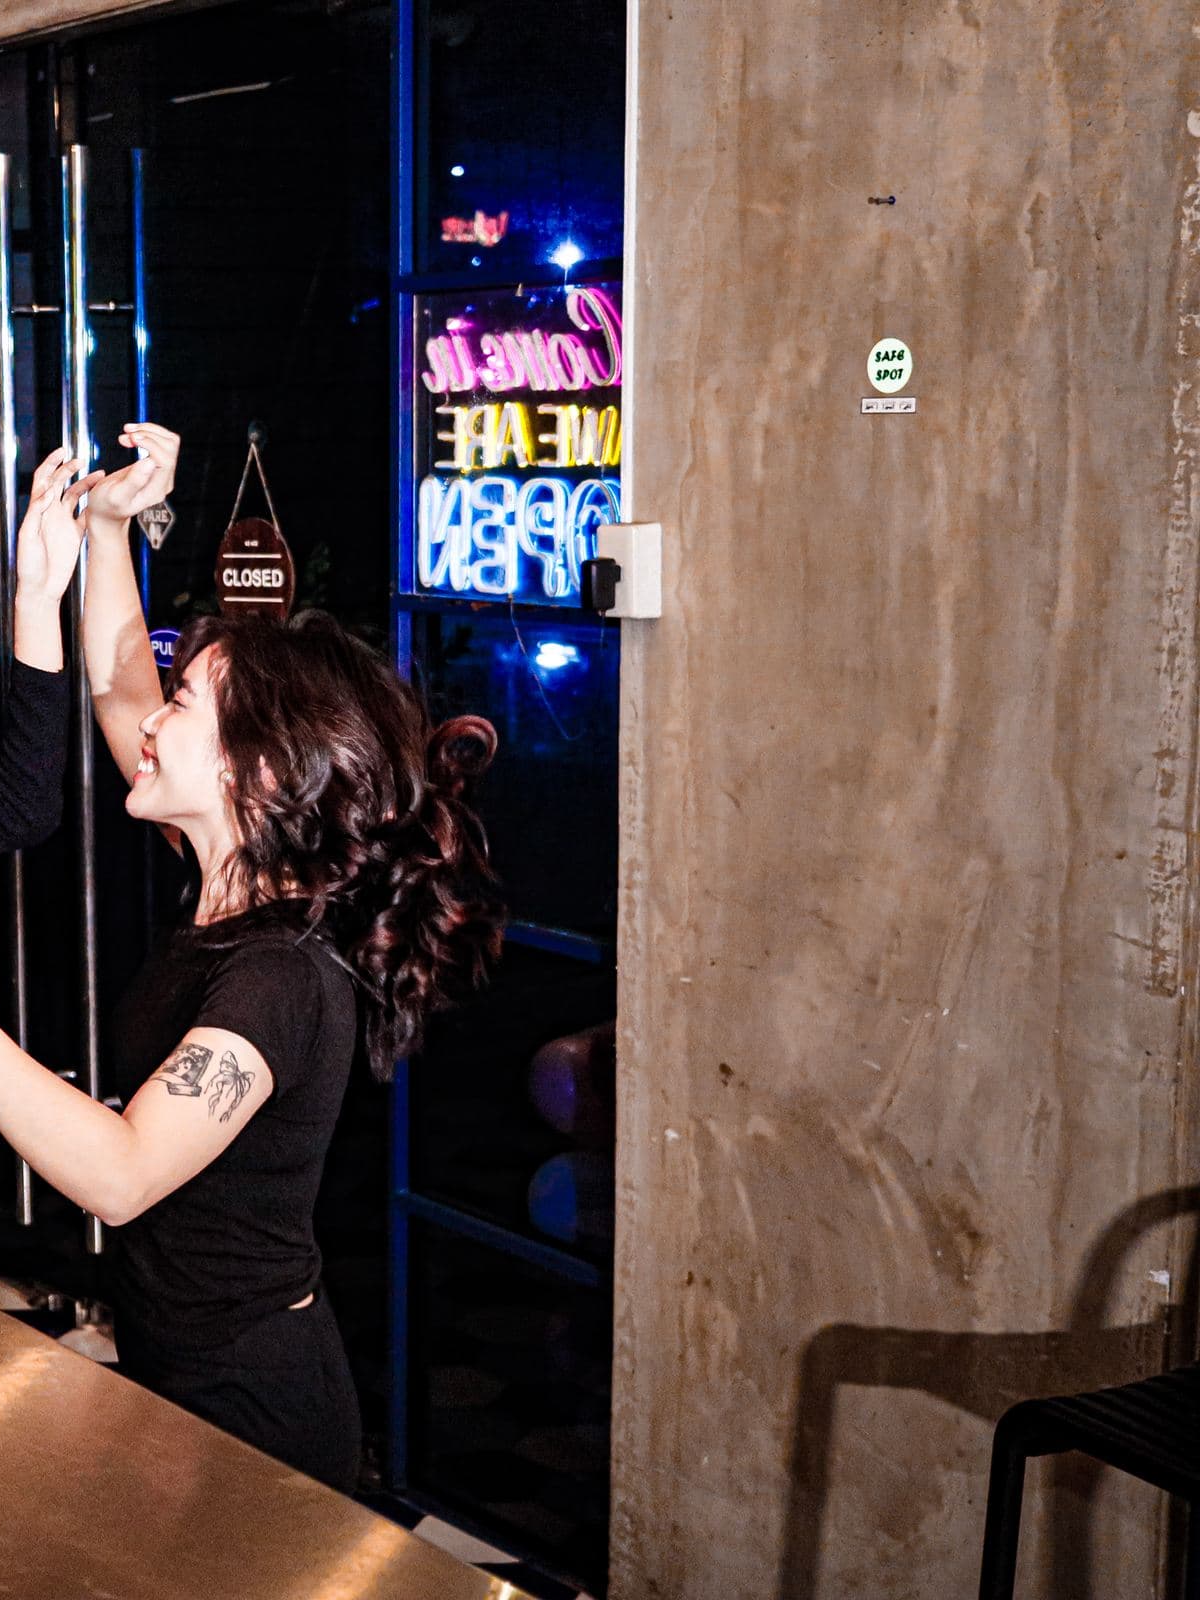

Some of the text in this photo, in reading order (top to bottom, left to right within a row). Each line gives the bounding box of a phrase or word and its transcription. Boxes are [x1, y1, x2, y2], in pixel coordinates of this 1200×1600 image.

[875, 368, 904, 381] SPOT
[142, 509, 169, 523] PARE
[222, 568, 284, 588] CLOSED
[151, 640, 174, 657] PUL
